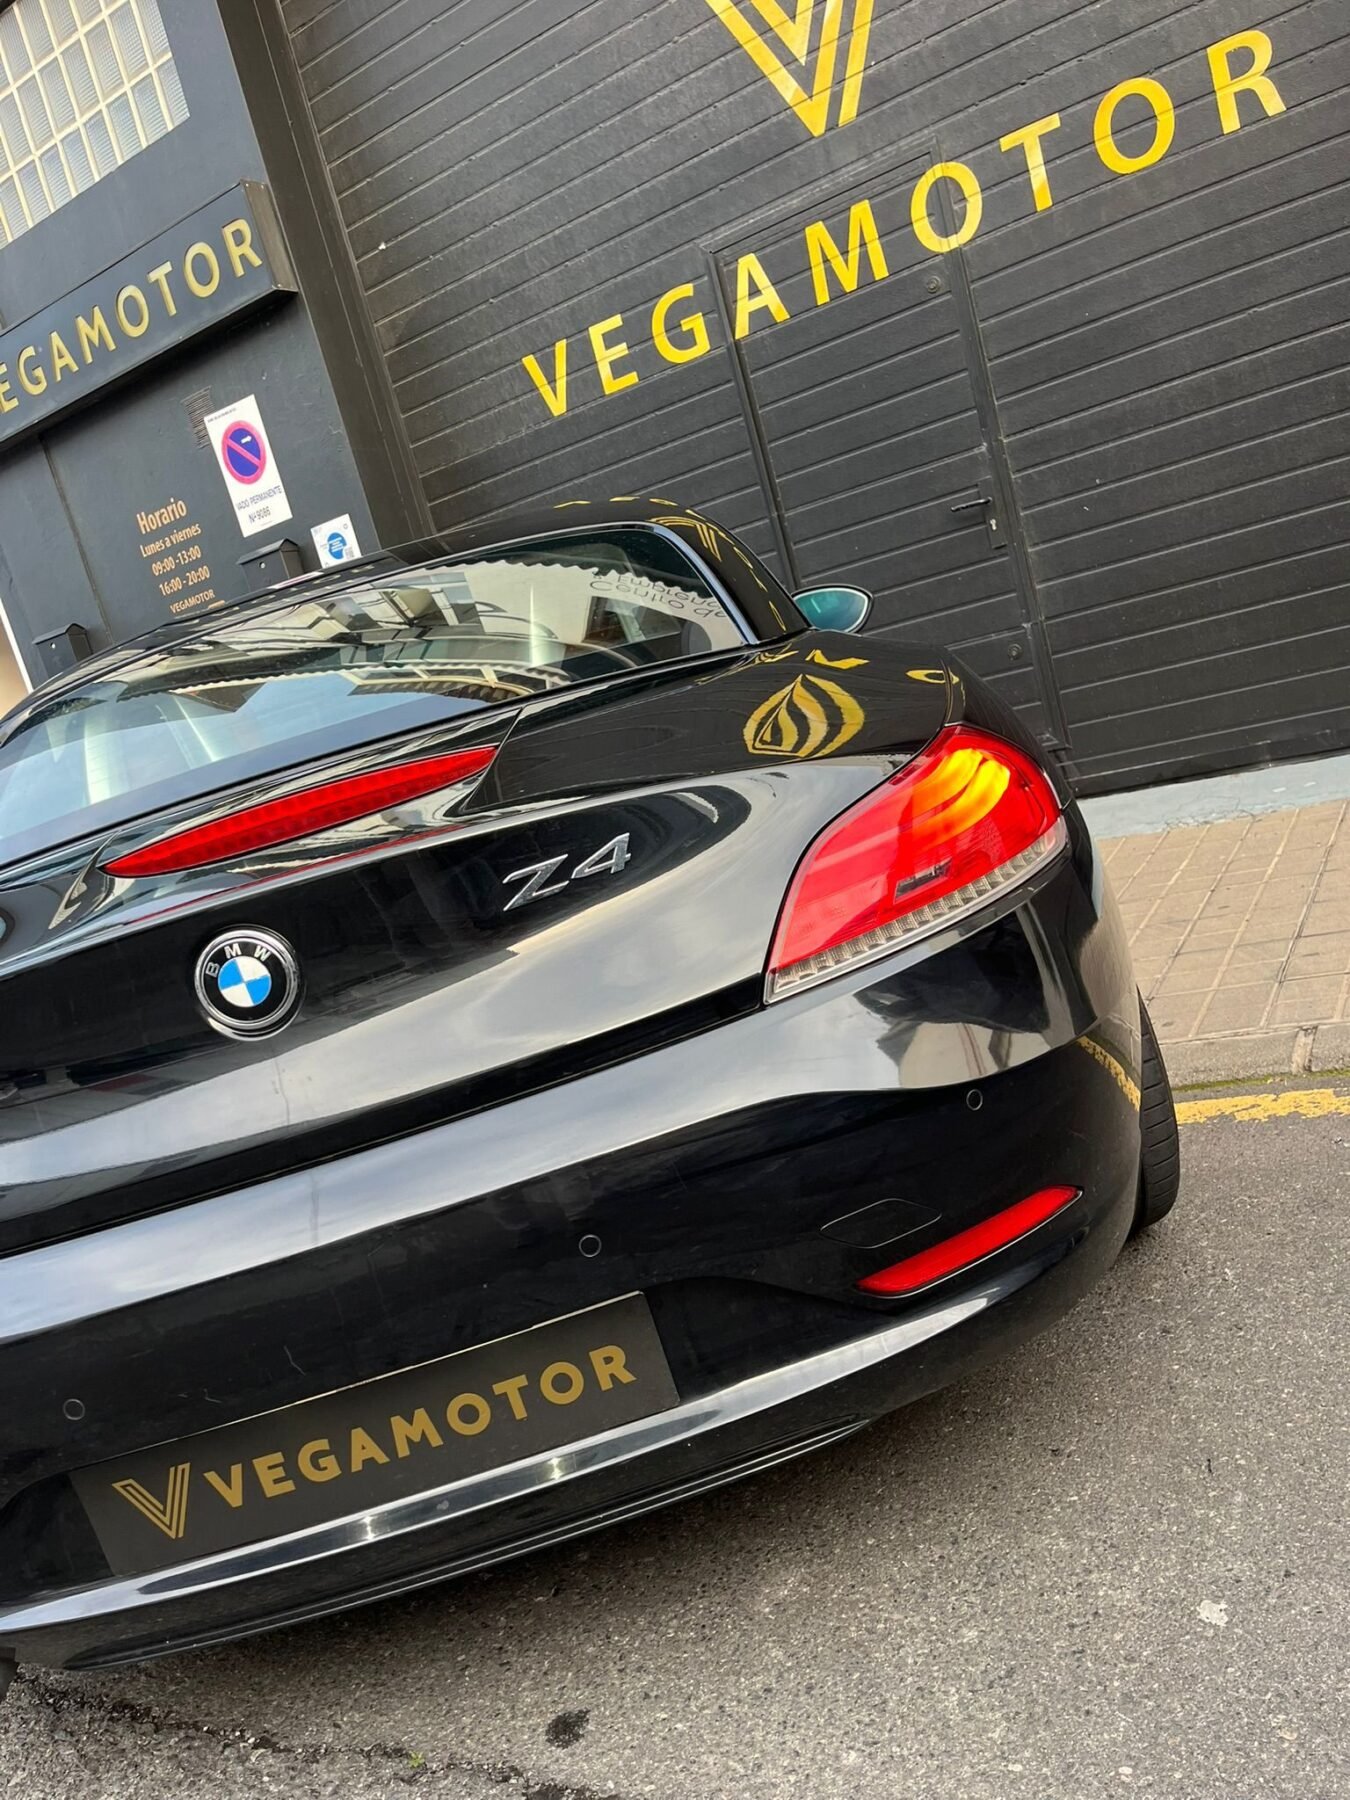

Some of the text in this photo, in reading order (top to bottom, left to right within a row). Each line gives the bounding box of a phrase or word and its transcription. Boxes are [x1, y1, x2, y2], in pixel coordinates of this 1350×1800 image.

[522, 30, 1287, 417] VEGAMOTOR
[136, 497, 188, 535] Horario
[140, 523, 202, 558] Lunes a viernes
[151, 556, 176, 577] 09:00
[159, 577, 183, 596] 16:00
[186, 565, 211, 586] 20:00
[170, 589, 216, 614] VEGAMOTOR
[502, 832, 632, 912] Z4
[205, 943, 272, 978] BMW
[203, 1344, 638, 1508] VEGAMOTOR
